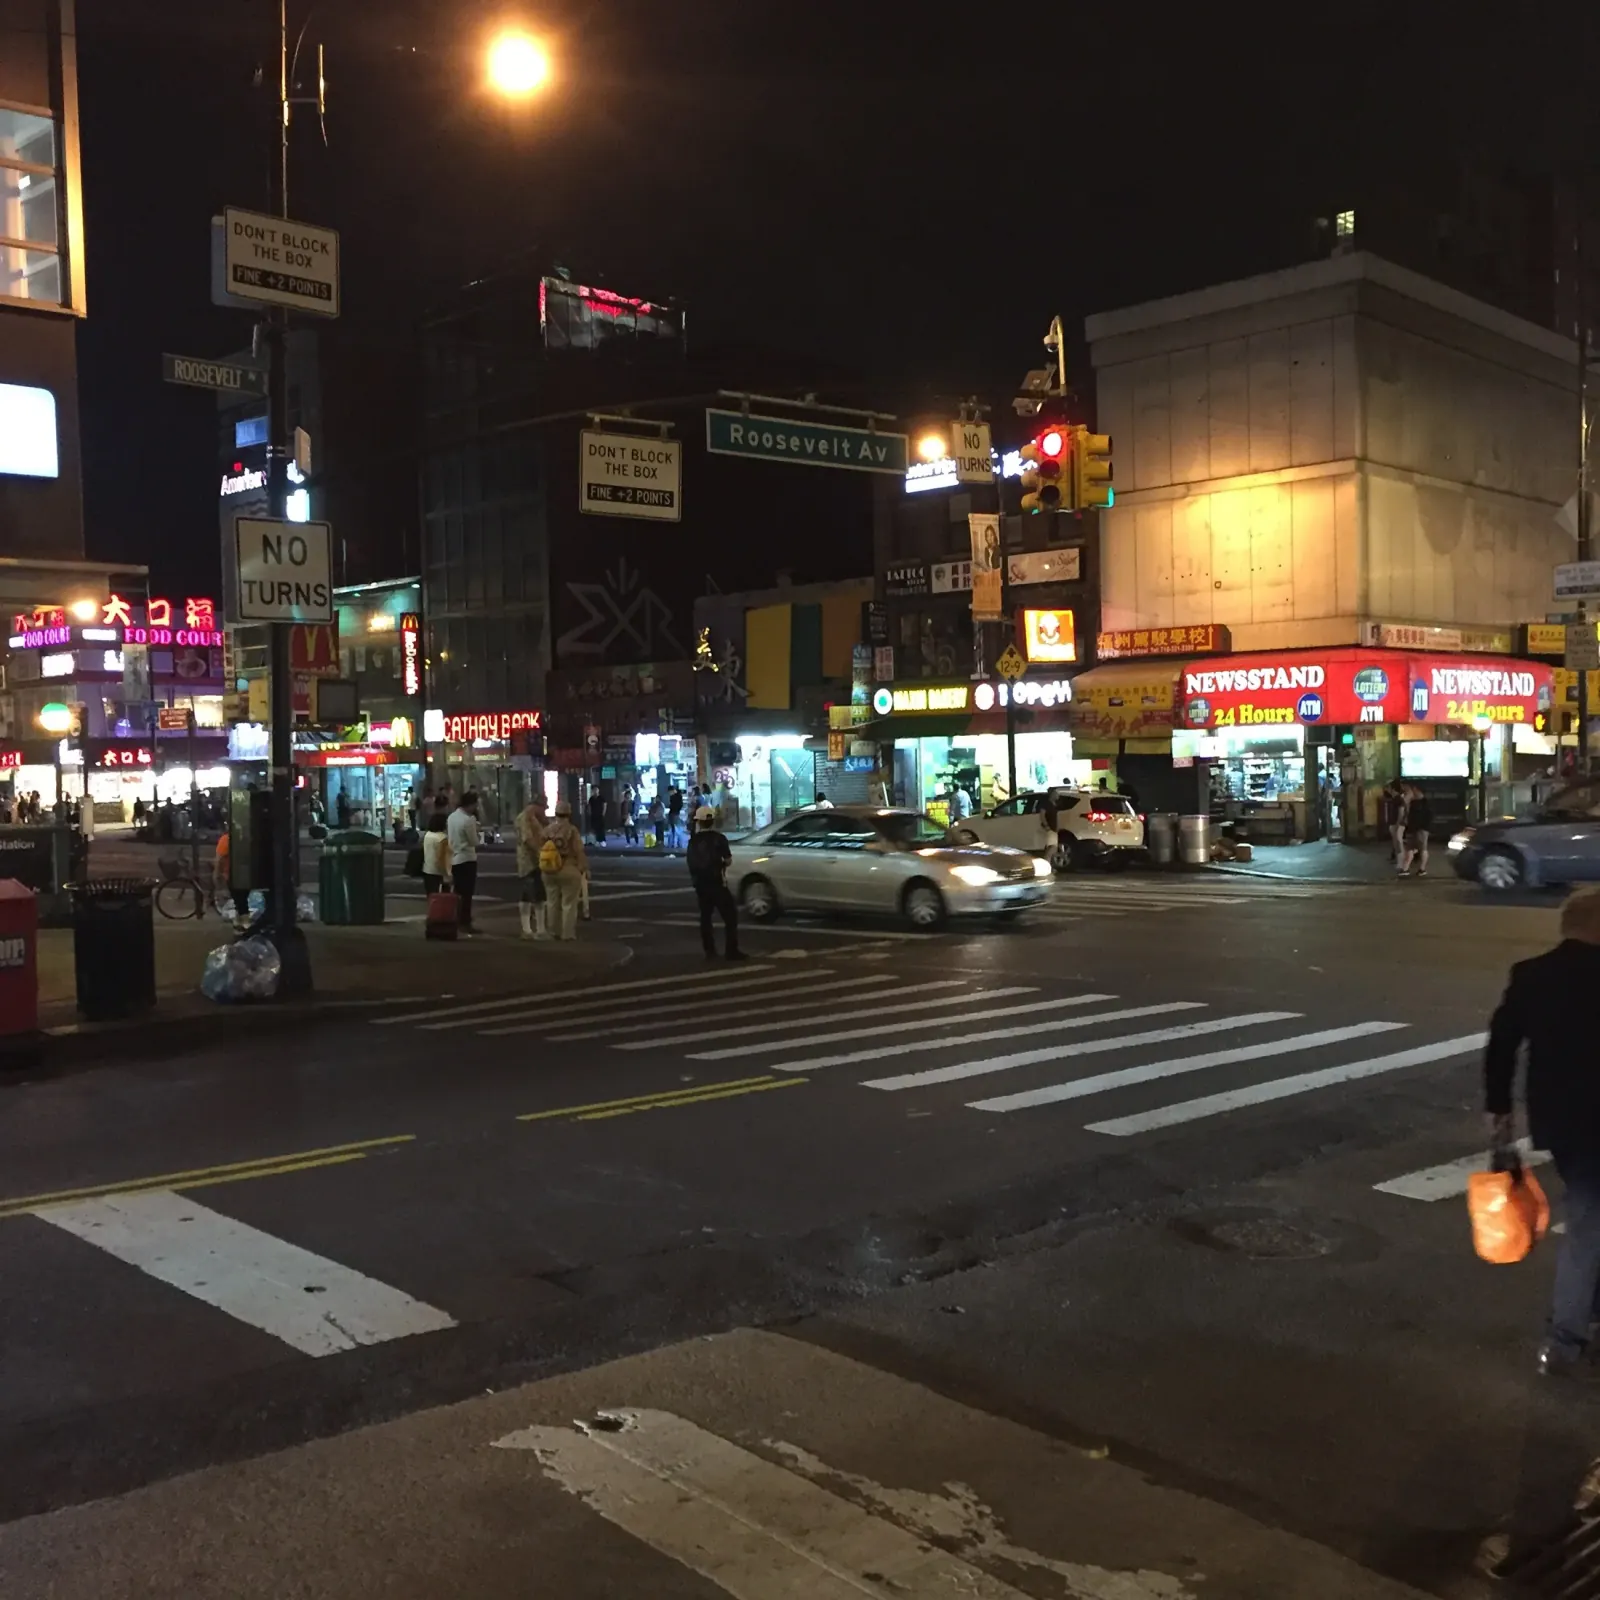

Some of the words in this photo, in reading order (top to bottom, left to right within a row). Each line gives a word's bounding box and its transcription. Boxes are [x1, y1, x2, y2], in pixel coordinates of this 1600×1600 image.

[234, 221, 276, 243] DON'T
[282, 233, 330, 255] BLOCK
[252, 244, 280, 262] THE
[286, 252, 313, 269] BOX
[236, 267, 262, 286] FINE
[266, 274, 286, 290] +2
[288, 279, 328, 299] POINTS
[174, 359, 242, 389] ROOSEVELT
[729, 423, 850, 459] Roosevelt
[858, 444, 887, 463] Av
[963, 433, 980, 450] NO
[588, 444, 626, 461] DON'T
[631, 448, 673, 465] BLOCK
[957, 457, 991, 474] TURNS
[604, 462, 629, 477] THE
[633, 465, 658, 480] BOX
[589, 486, 613, 501] FINE
[616, 489, 633, 502] +2
[636, 491, 671, 505] POINTS
[262, 533, 308, 566] NO
[243, 580, 328, 607] TURNS
[102, 594, 214, 629] 大口福
[124, 628, 171, 644] FOOD
[1000, 660, 1021, 673] 12-9
[1186, 665, 1325, 694] NEWSSTAND
[1355, 682, 1387, 694] LOTTERY
[1431, 668, 1535, 697] NEWSSTAND
[1299, 700, 1321, 716] ATM
[1412, 687, 1429, 712] ATM
[1446, 701, 1471, 722] 24
[1471, 700, 1525, 721] Hours
[1214, 707, 1235, 727] 24
[1239, 704, 1294, 724] Hours
[1360, 706, 1384, 723] ATM
[443, 713, 500, 742] CATHAY
[501, 712, 540, 739] BANK
